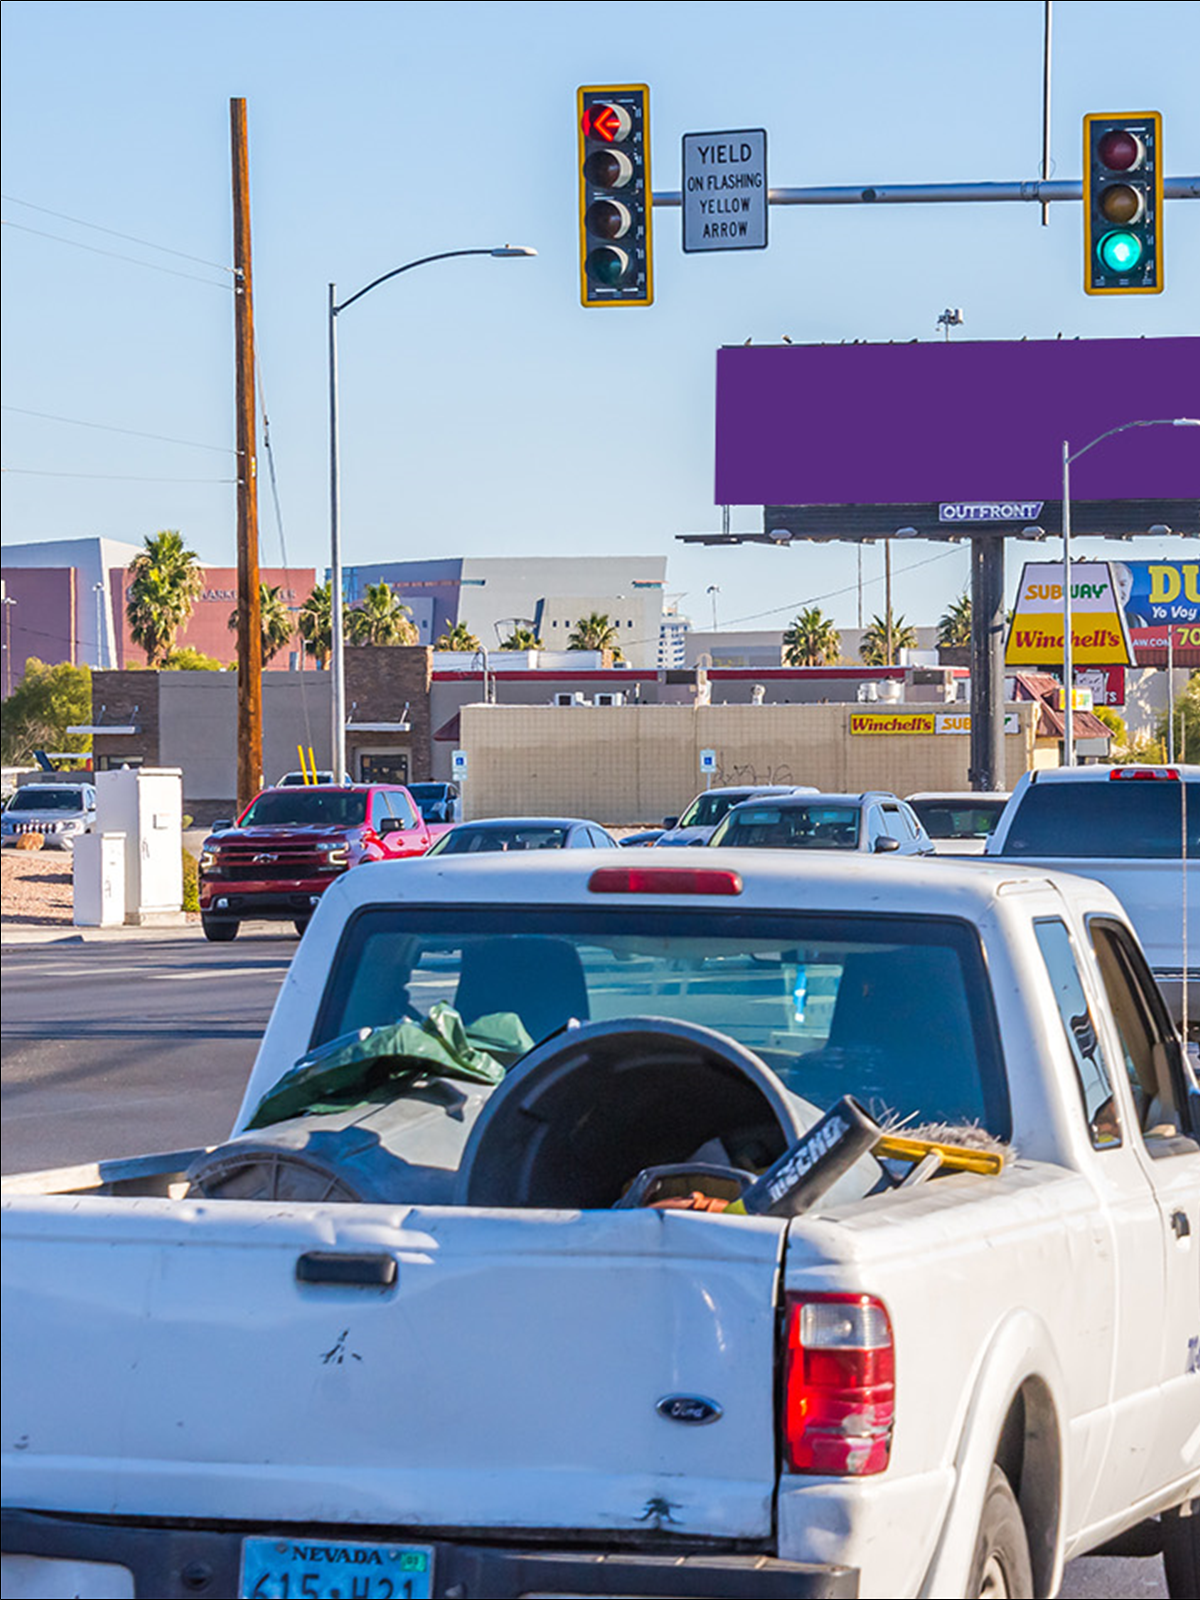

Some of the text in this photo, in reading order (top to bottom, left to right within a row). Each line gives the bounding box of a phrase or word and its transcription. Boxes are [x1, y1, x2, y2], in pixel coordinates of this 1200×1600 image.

[698, 143, 752, 164] YIELD
[687, 173, 762, 192] ON FLASHING
[700, 198, 750, 214] YELLOW
[703, 222, 748, 238] ARROW
[943, 504, 1037, 519] OUTFRONT
[1152, 606, 1167, 619] Yo
[1171, 605, 1196, 621] Voy
[852, 717, 931, 732] Winchell's
[671, 1403, 704, 1417] Ford
[291, 1546, 383, 1565] NEVADA
